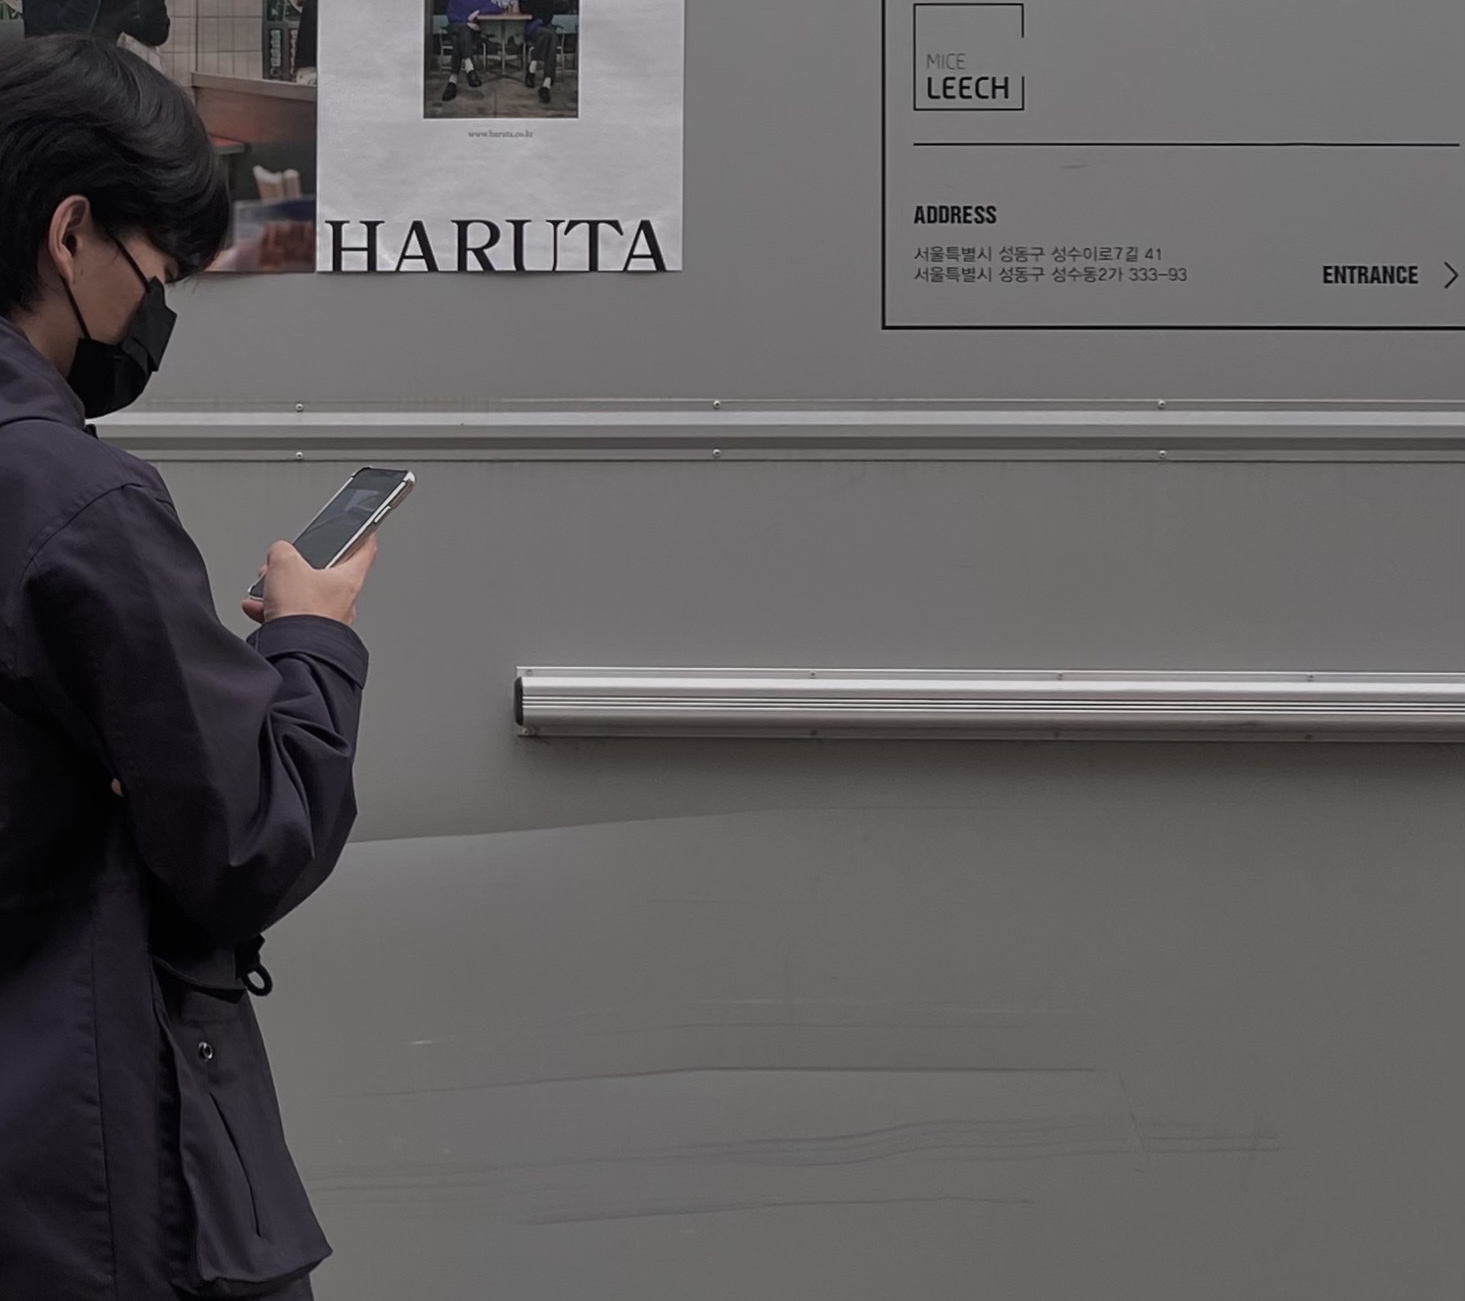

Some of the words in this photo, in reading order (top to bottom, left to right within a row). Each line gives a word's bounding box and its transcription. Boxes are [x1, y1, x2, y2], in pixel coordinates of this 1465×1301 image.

[927, 52, 966, 70] MICE
[927, 76, 1009, 99] LEECH
[914, 205, 997, 224] ADDRESS
[325, 219, 667, 272] HARUTA
[914, 246, 992, 263] 서울특별시
[999, 246, 1045, 263] 성동구
[1051, 246, 1139, 263] 성수이로7길
[1144, 247, 1163, 262] 41
[914, 266, 992, 283] 서울특별시
[999, 266, 1045, 283] 성동구
[1051, 266, 1123, 283] 성수동2가
[1128, 266, 1188, 283] 333-93
[1322, 265, 1419, 284] ENTRANCE
